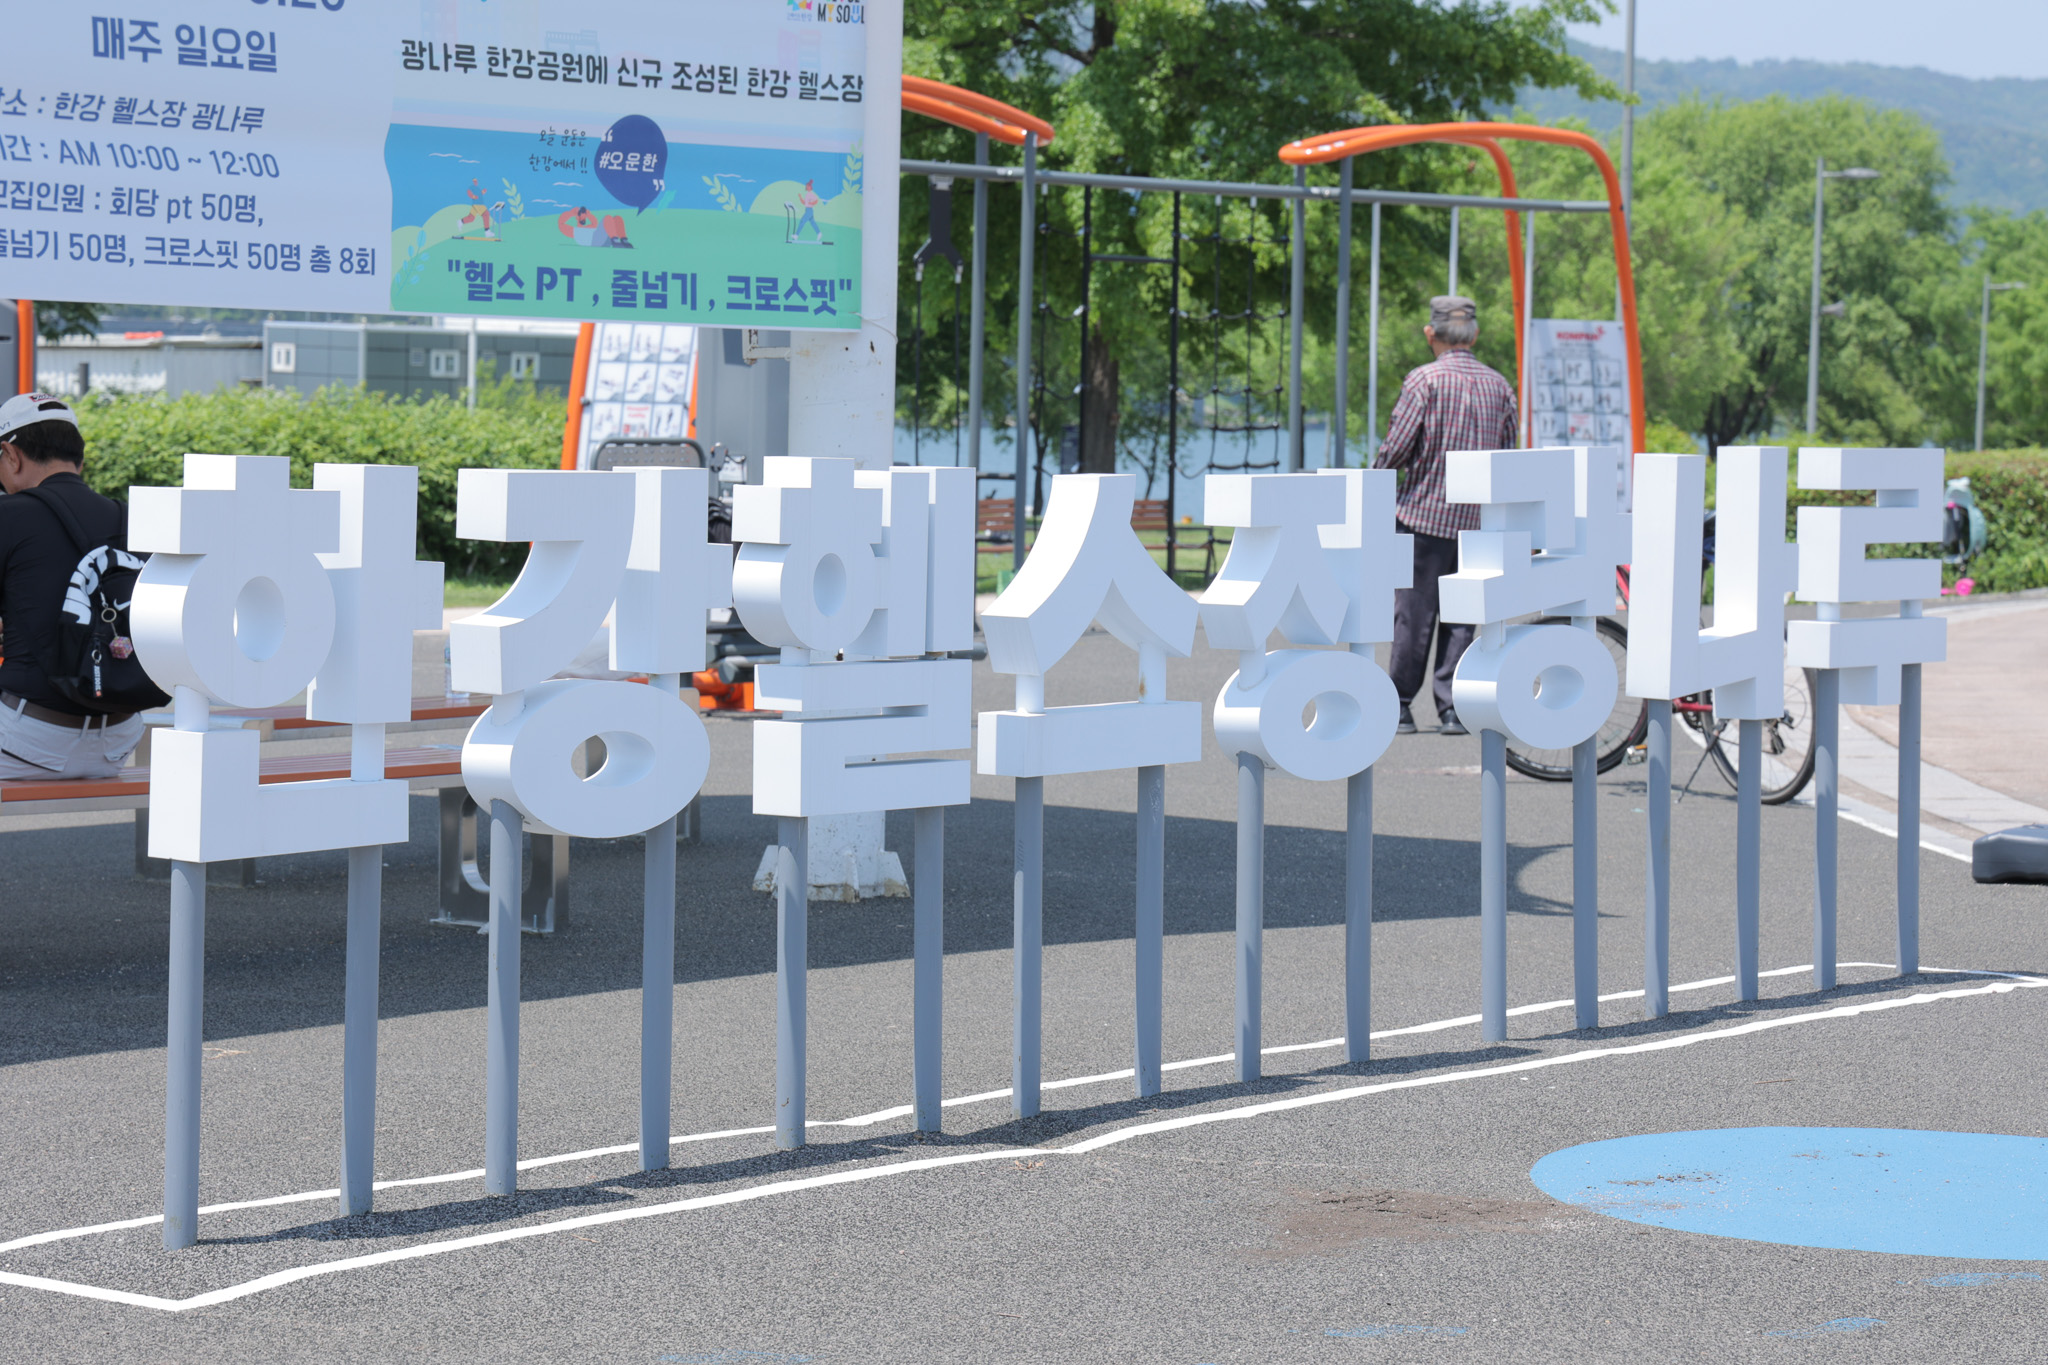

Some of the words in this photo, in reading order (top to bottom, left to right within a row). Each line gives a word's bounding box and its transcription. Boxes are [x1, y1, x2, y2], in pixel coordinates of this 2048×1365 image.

[836, 4, 865, 24] SOUL
[91, 16, 163, 63] 매주
[174, 24, 278, 73] 일요일
[401, 39, 478, 74] 광나루
[486, 46, 608, 85] 한강공원에
[617, 57, 663, 89] 신규
[671, 62, 738, 95] 조성된
[747, 67, 792, 99] 한강
[798, 70, 864, 103] 헬스장
[53, 92, 106, 122] 한강
[112, 96, 188, 128] 헬스장
[191, 103, 265, 134] 광나루
[539, 126, 557, 146] 오늘
[561, 128, 587, 147] 운동은
[59, 139, 101, 167] AM
[106, 142, 180, 172] 10:00
[209, 150, 280, 179] 12:00
[528, 153, 576, 172] 한강에서
[599, 151, 658, 172] #오운한
[109, 186, 160, 218] 회당
[166, 195, 193, 224] pt
[201, 193, 263, 228] 50명,
[69, 232, 135, 268] 50명,
[143, 236, 239, 270] 크로스핏
[247, 242, 301, 272] 50명
[309, 244, 332, 274] 총
[339, 247, 376, 276] 8회
[447, 259, 525, 302] "헬스
[726, 275, 853, 316] 크로스핏"
